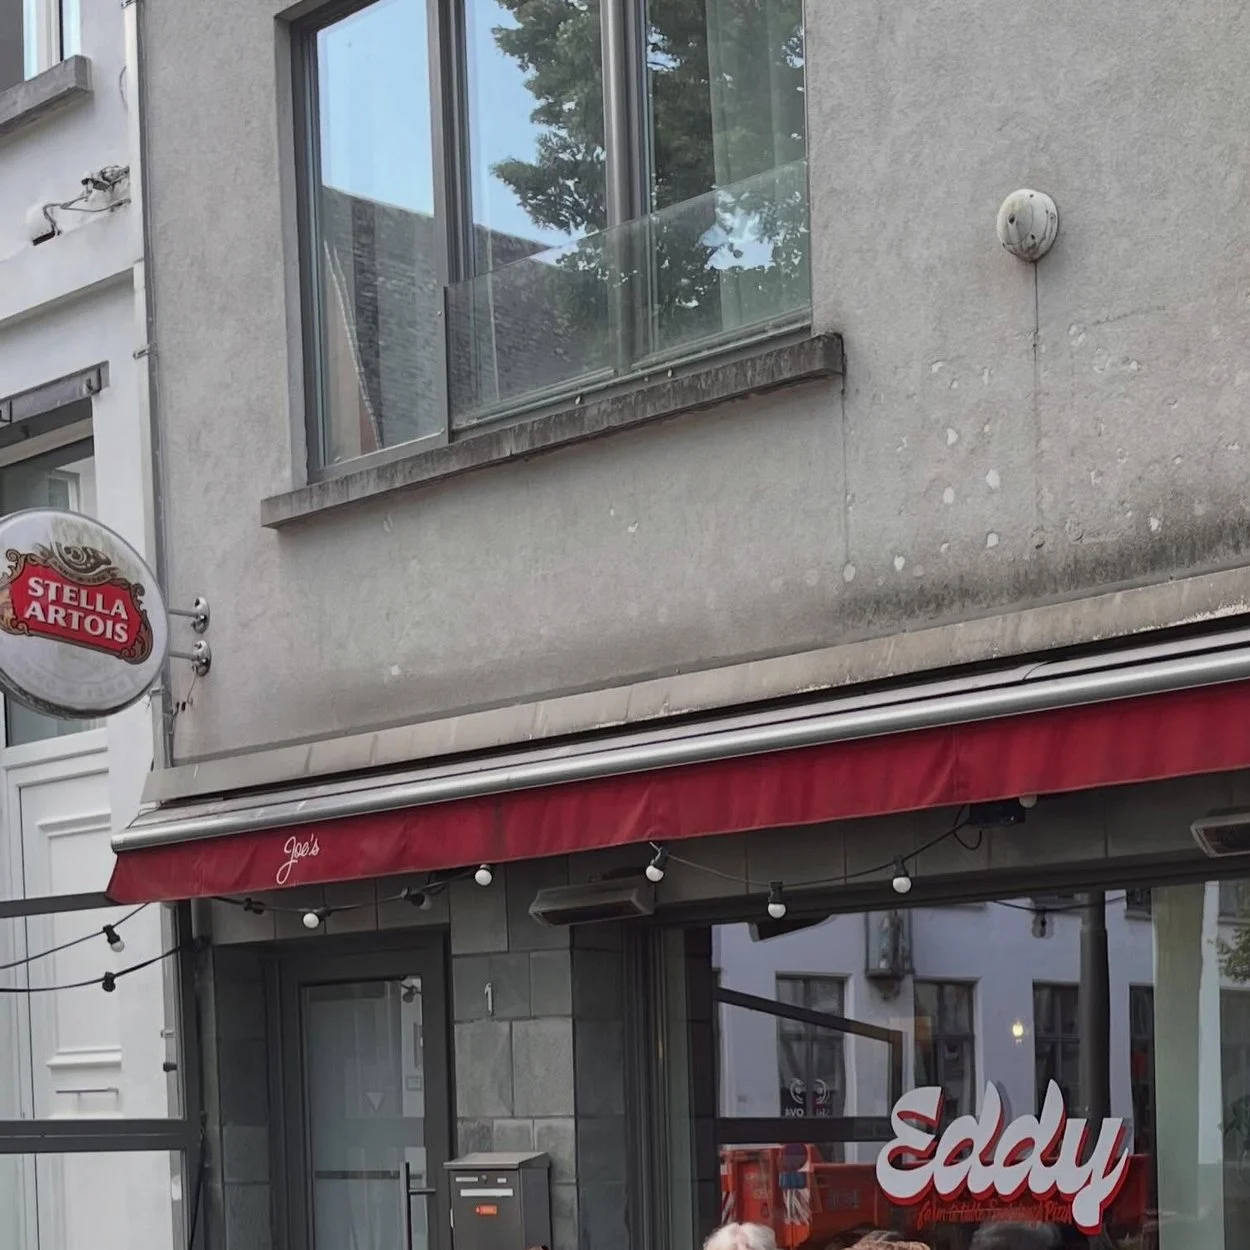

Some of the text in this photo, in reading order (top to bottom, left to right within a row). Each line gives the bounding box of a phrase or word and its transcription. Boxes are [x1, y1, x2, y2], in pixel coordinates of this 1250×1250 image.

[28, 577, 129, 620] STELLA
[24, 602, 129, 643] ARTOIS
[276, 833, 320, 885] Joe's
[484, 982, 494, 1014] 1
[876, 1079, 1130, 1235] Eddy
